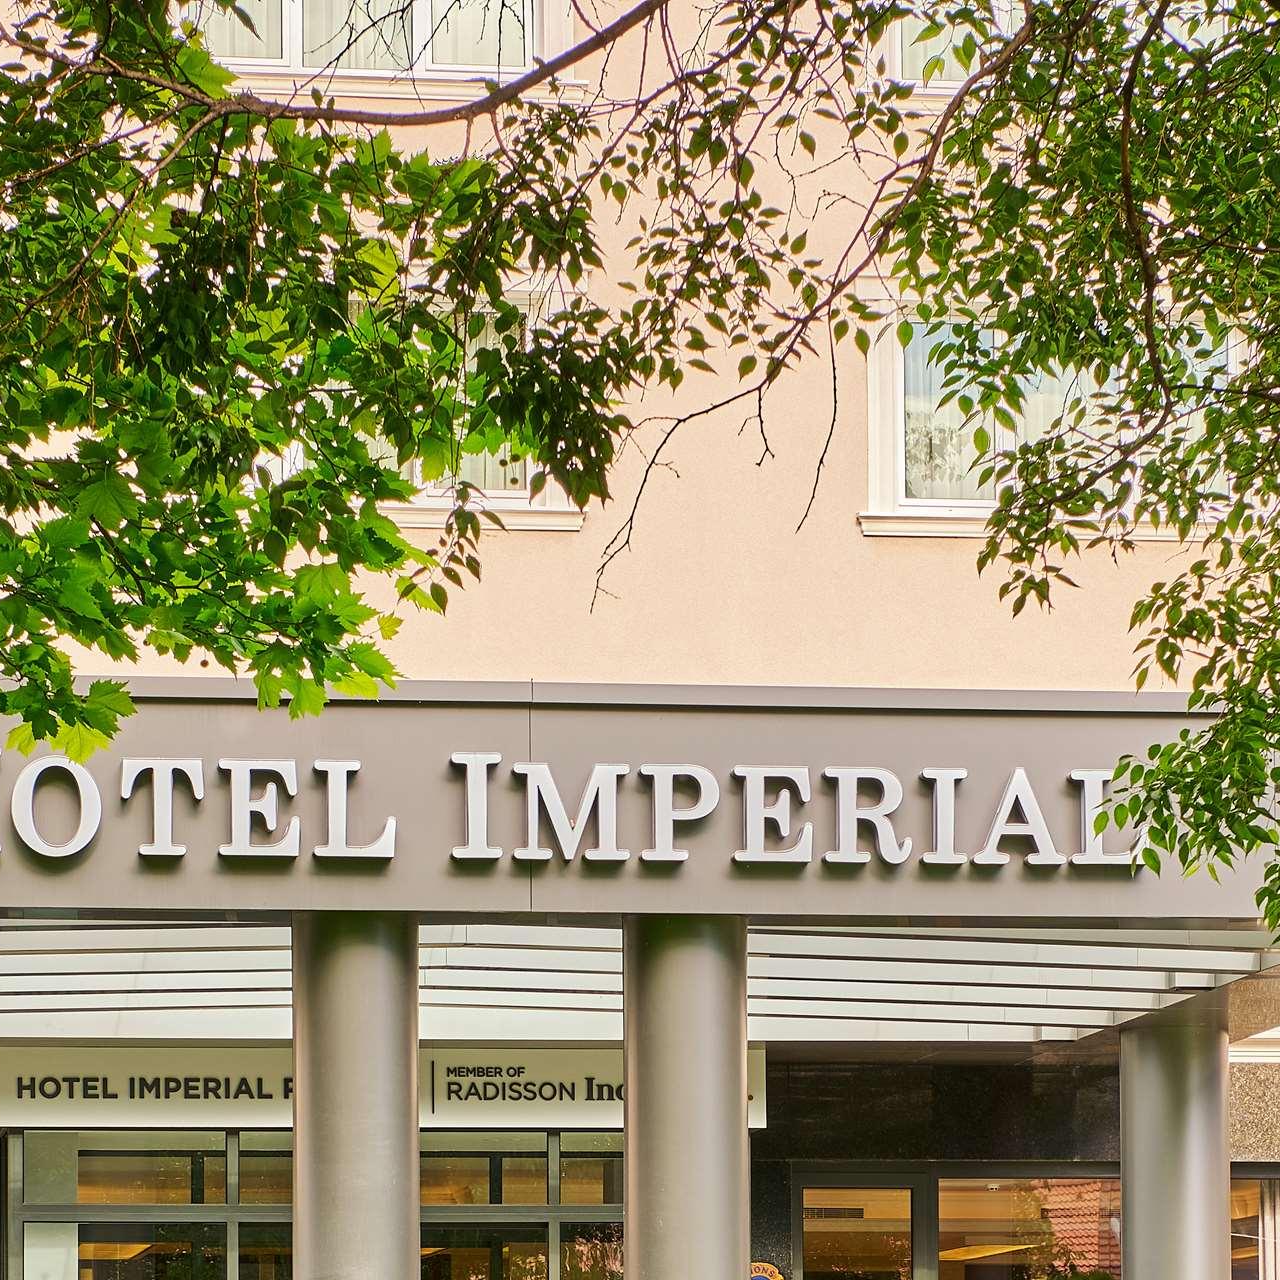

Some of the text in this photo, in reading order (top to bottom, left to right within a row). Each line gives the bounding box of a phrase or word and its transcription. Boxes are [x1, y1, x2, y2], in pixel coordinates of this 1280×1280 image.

[450, 752, 1150, 865] IMPERIAL
[446, 1067, 525, 1078] MEMBER OF
[17, 1077, 118, 1099] HOTEL
[129, 1077, 273, 1099] IMPERIAL
[447, 1082, 576, 1101] RADISSON
